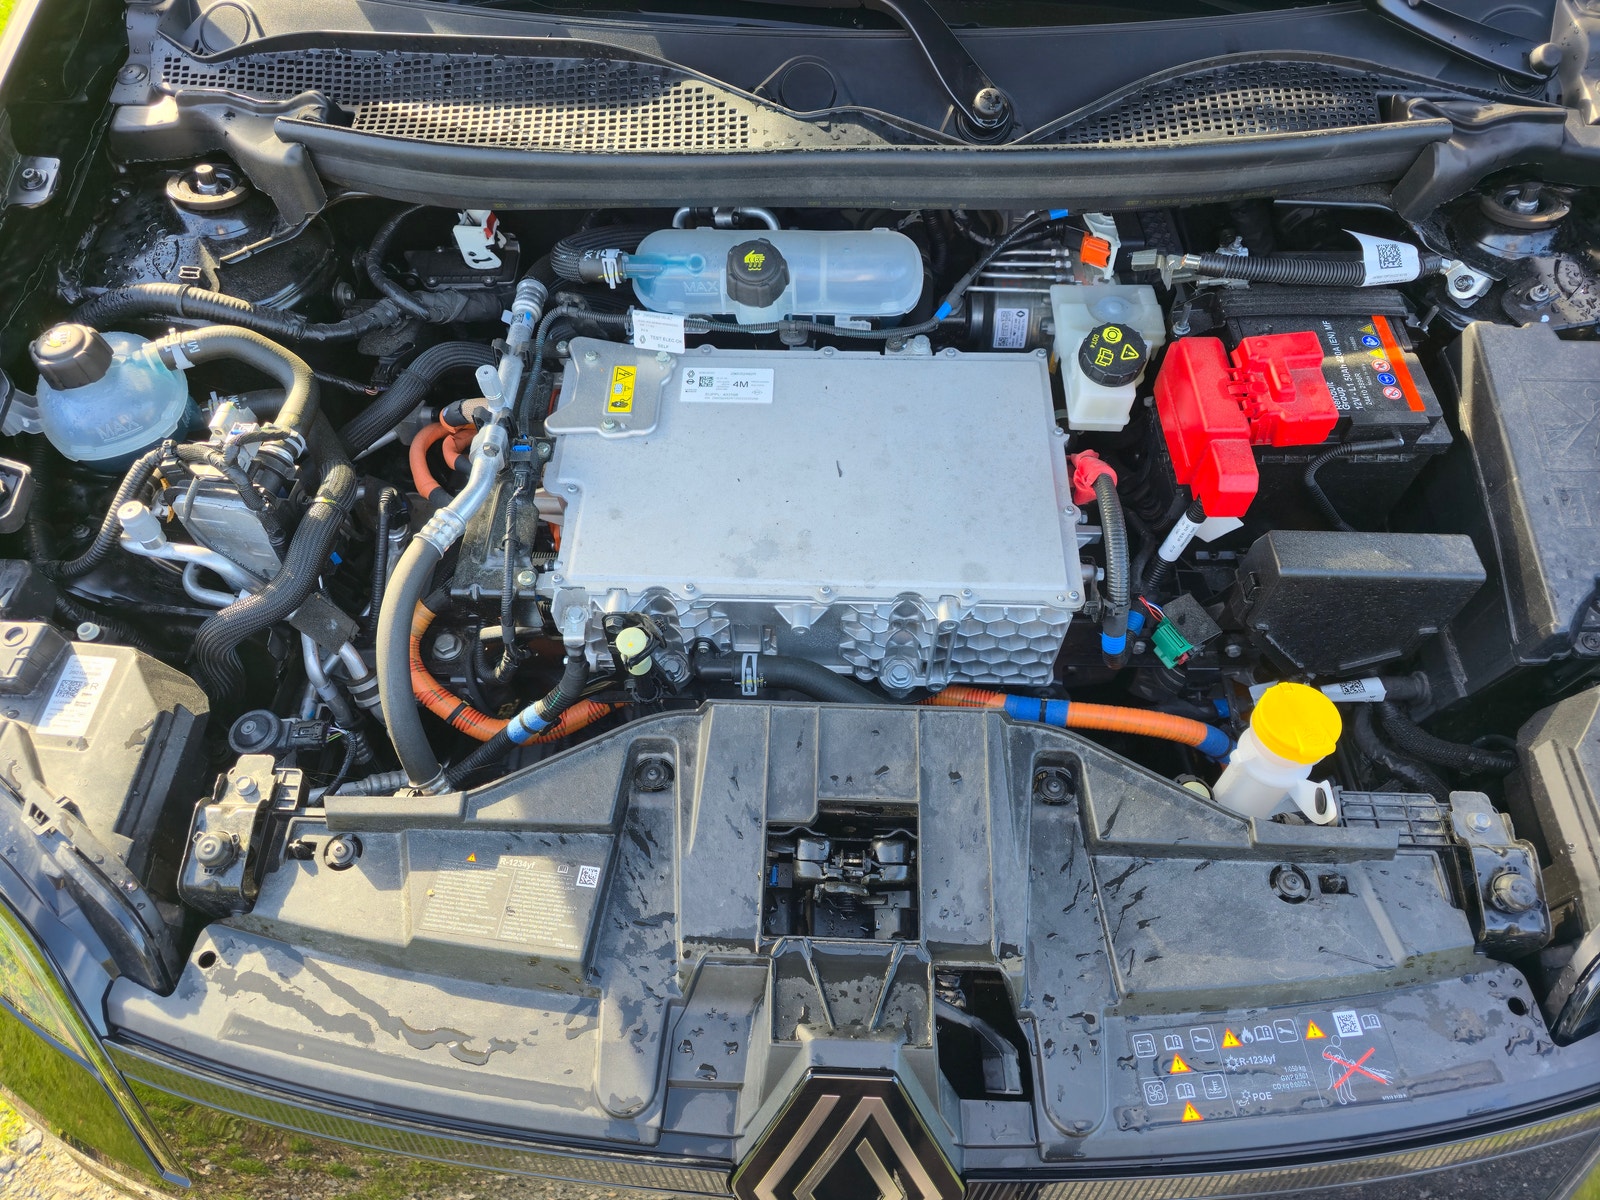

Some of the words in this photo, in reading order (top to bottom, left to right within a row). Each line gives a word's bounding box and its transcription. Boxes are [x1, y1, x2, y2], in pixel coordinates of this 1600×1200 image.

[683, 281, 718, 293] MAX
[1322, 320, 1333, 330] MF
[1340, 364, 1352, 381] 50Ah
[1337, 386, 1350, 410] Group
[1352, 397, 1363, 410] 12V
[96, 414, 140, 439] MAX
[500, 857, 536, 870] R-1234yf
[1240, 1053, 1276, 1066] R-1234yf
[1252, 1091, 1273, 1101] POE
